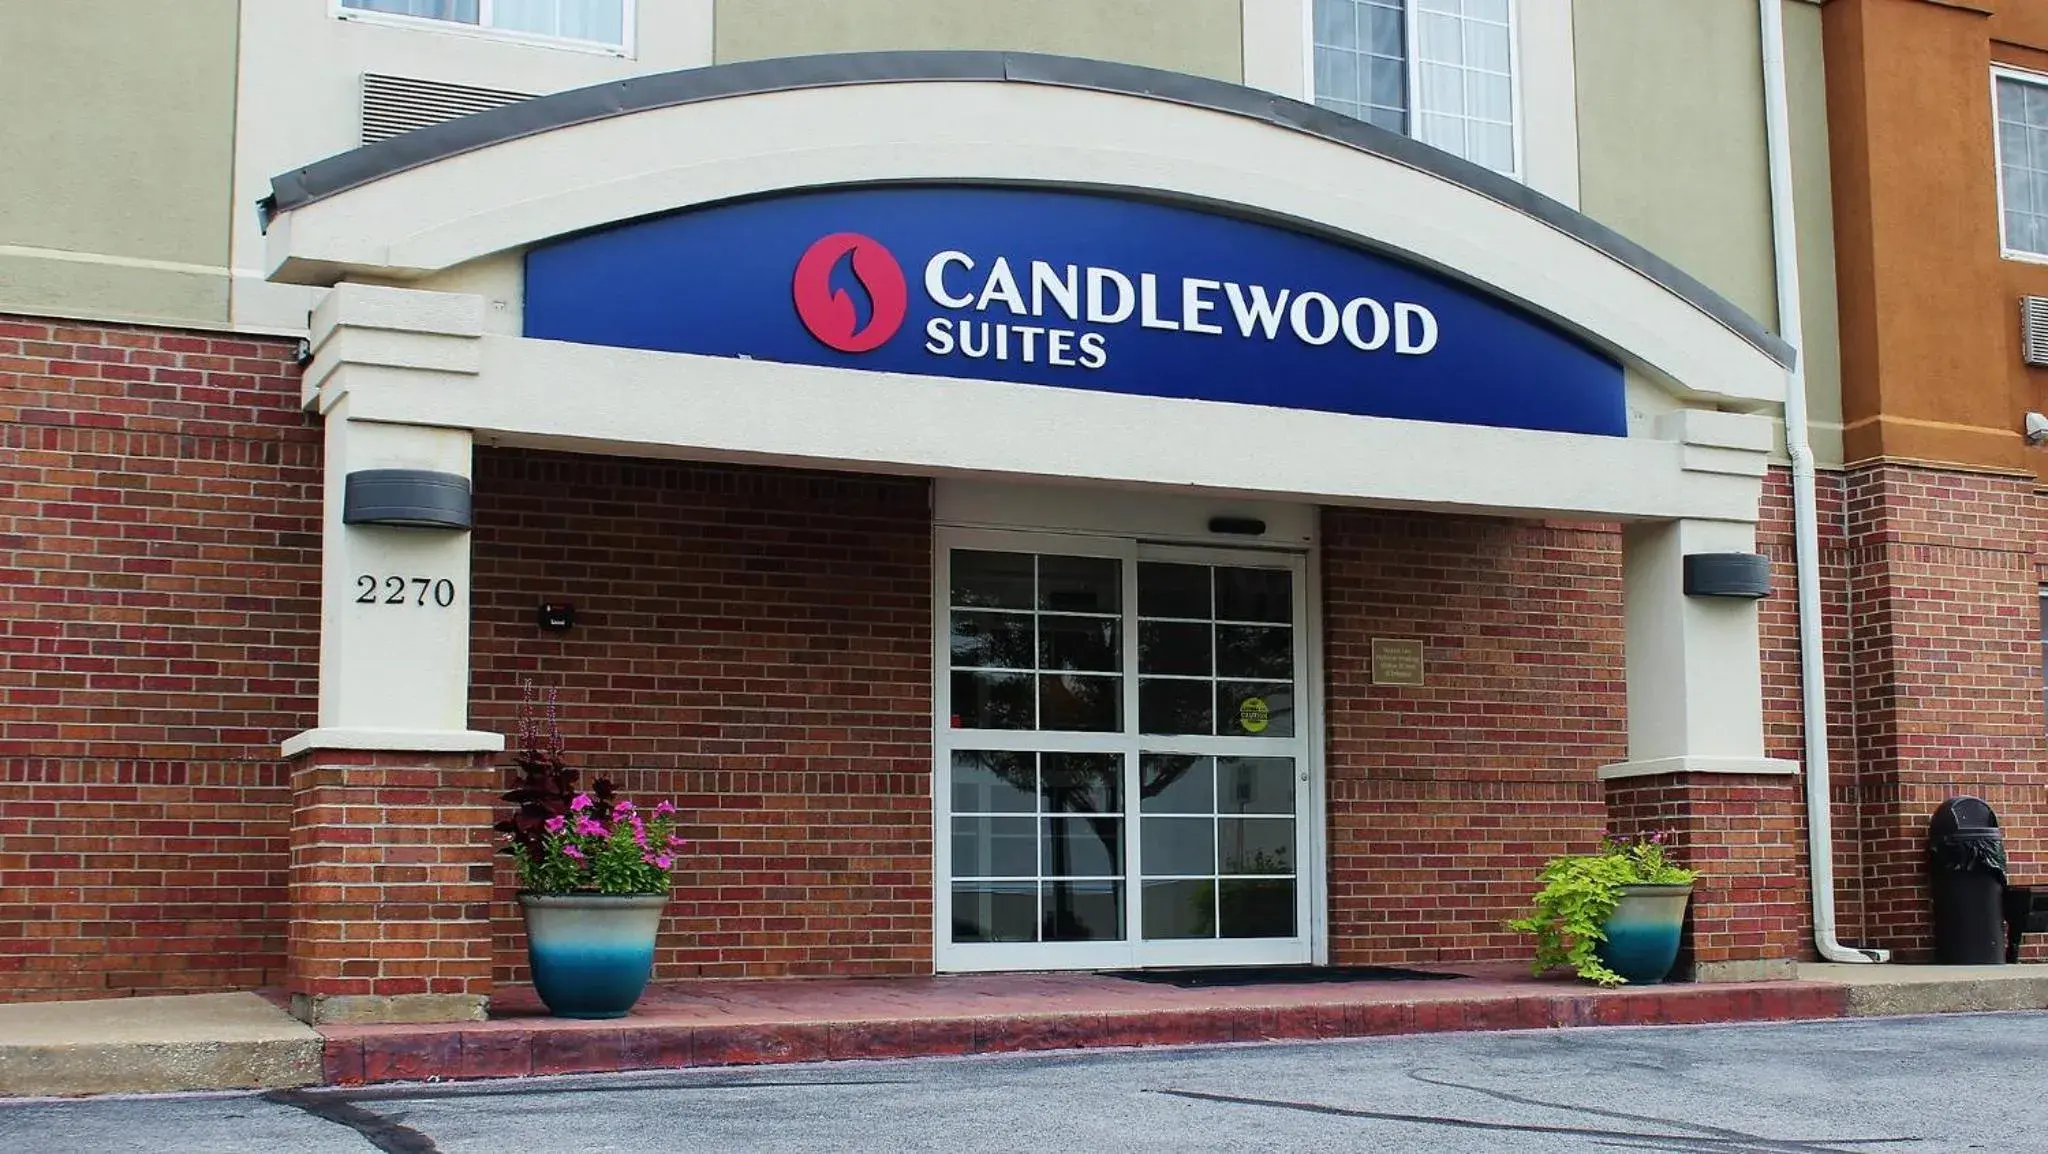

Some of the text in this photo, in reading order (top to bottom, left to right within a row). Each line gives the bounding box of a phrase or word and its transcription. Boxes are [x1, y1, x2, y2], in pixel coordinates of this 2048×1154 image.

[924, 250, 1438, 355] CANDLEWOOD
[925, 317, 1107, 369] SUITES
[356, 574, 455, 608] 2270
